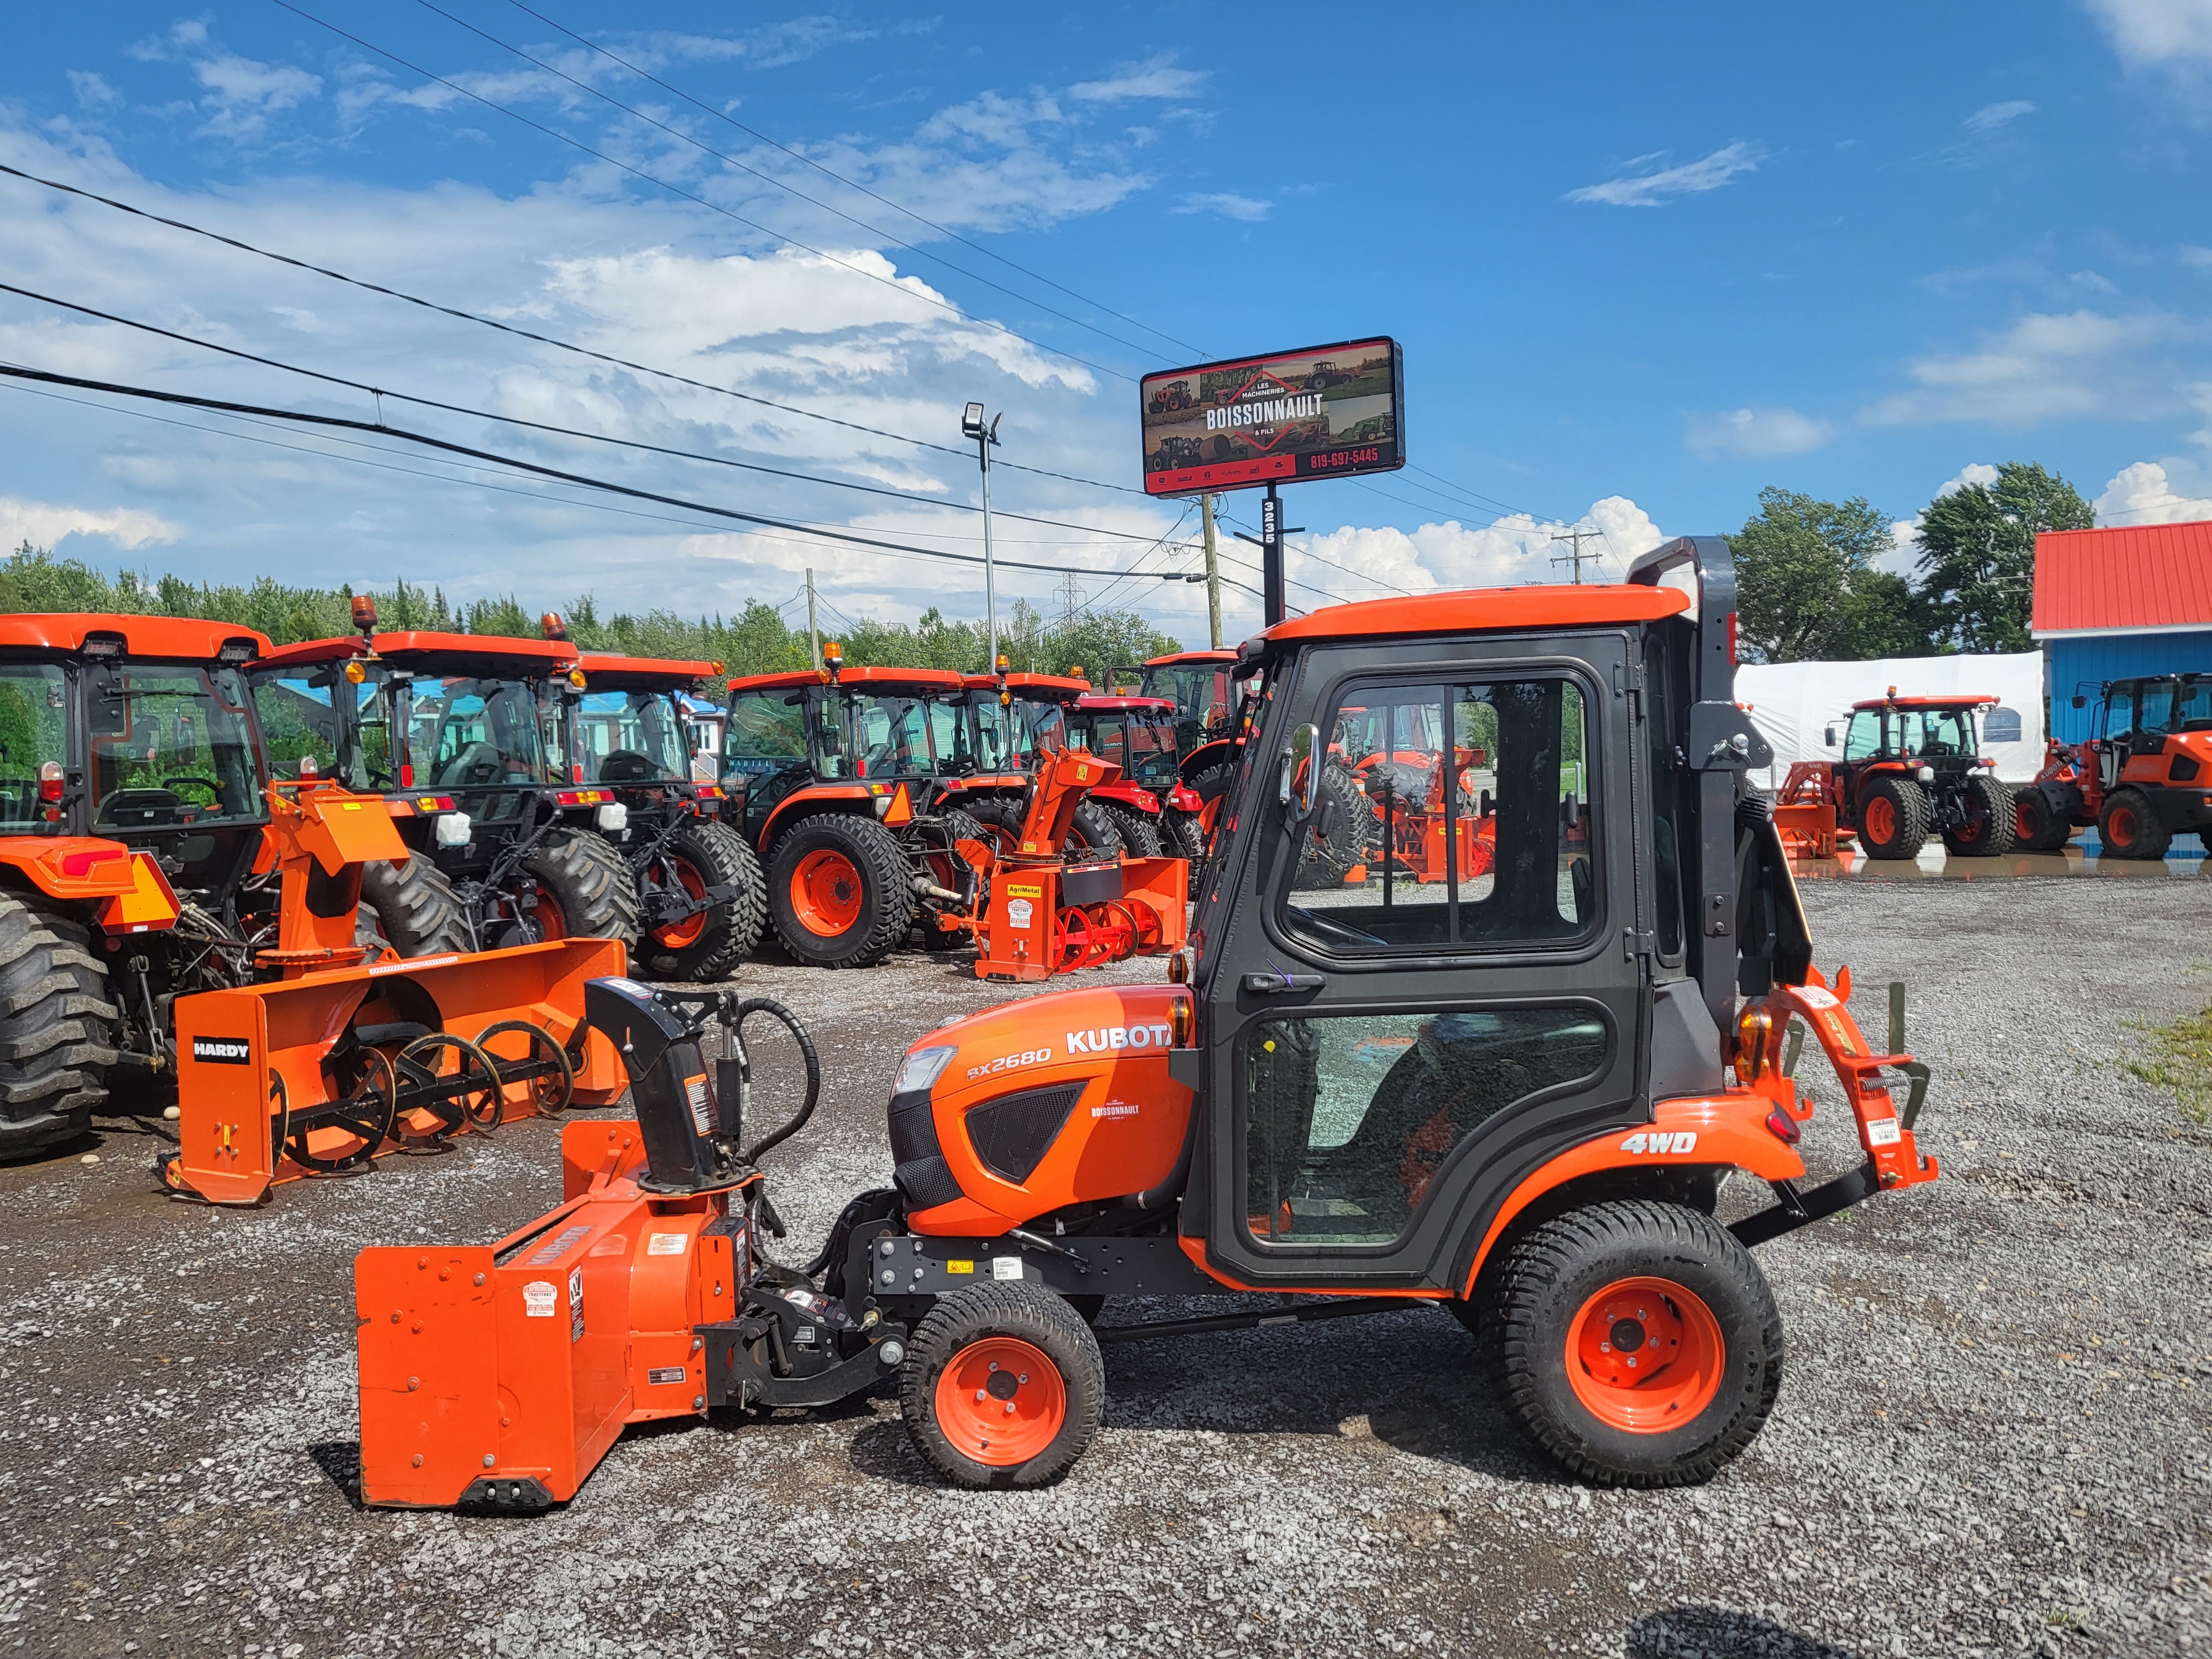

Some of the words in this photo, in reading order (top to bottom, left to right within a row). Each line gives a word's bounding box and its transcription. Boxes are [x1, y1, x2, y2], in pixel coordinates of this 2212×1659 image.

[1242, 387, 1285, 399] MACHINERIES
[1207, 393, 1323, 431] BOISSONNAULT
[1311, 447, 1378, 469] 819-697-5445
[1264, 501, 1275, 544] 3235
[194, 1042, 249, 1058] HARDY
[967, 1047, 1052, 1082] BX2680
[1091, 1104, 1139, 1117] BOISSONNAULT
[1620, 1131, 1698, 1155] 4WD
[524, 1225, 598, 1265] KUBOTA
